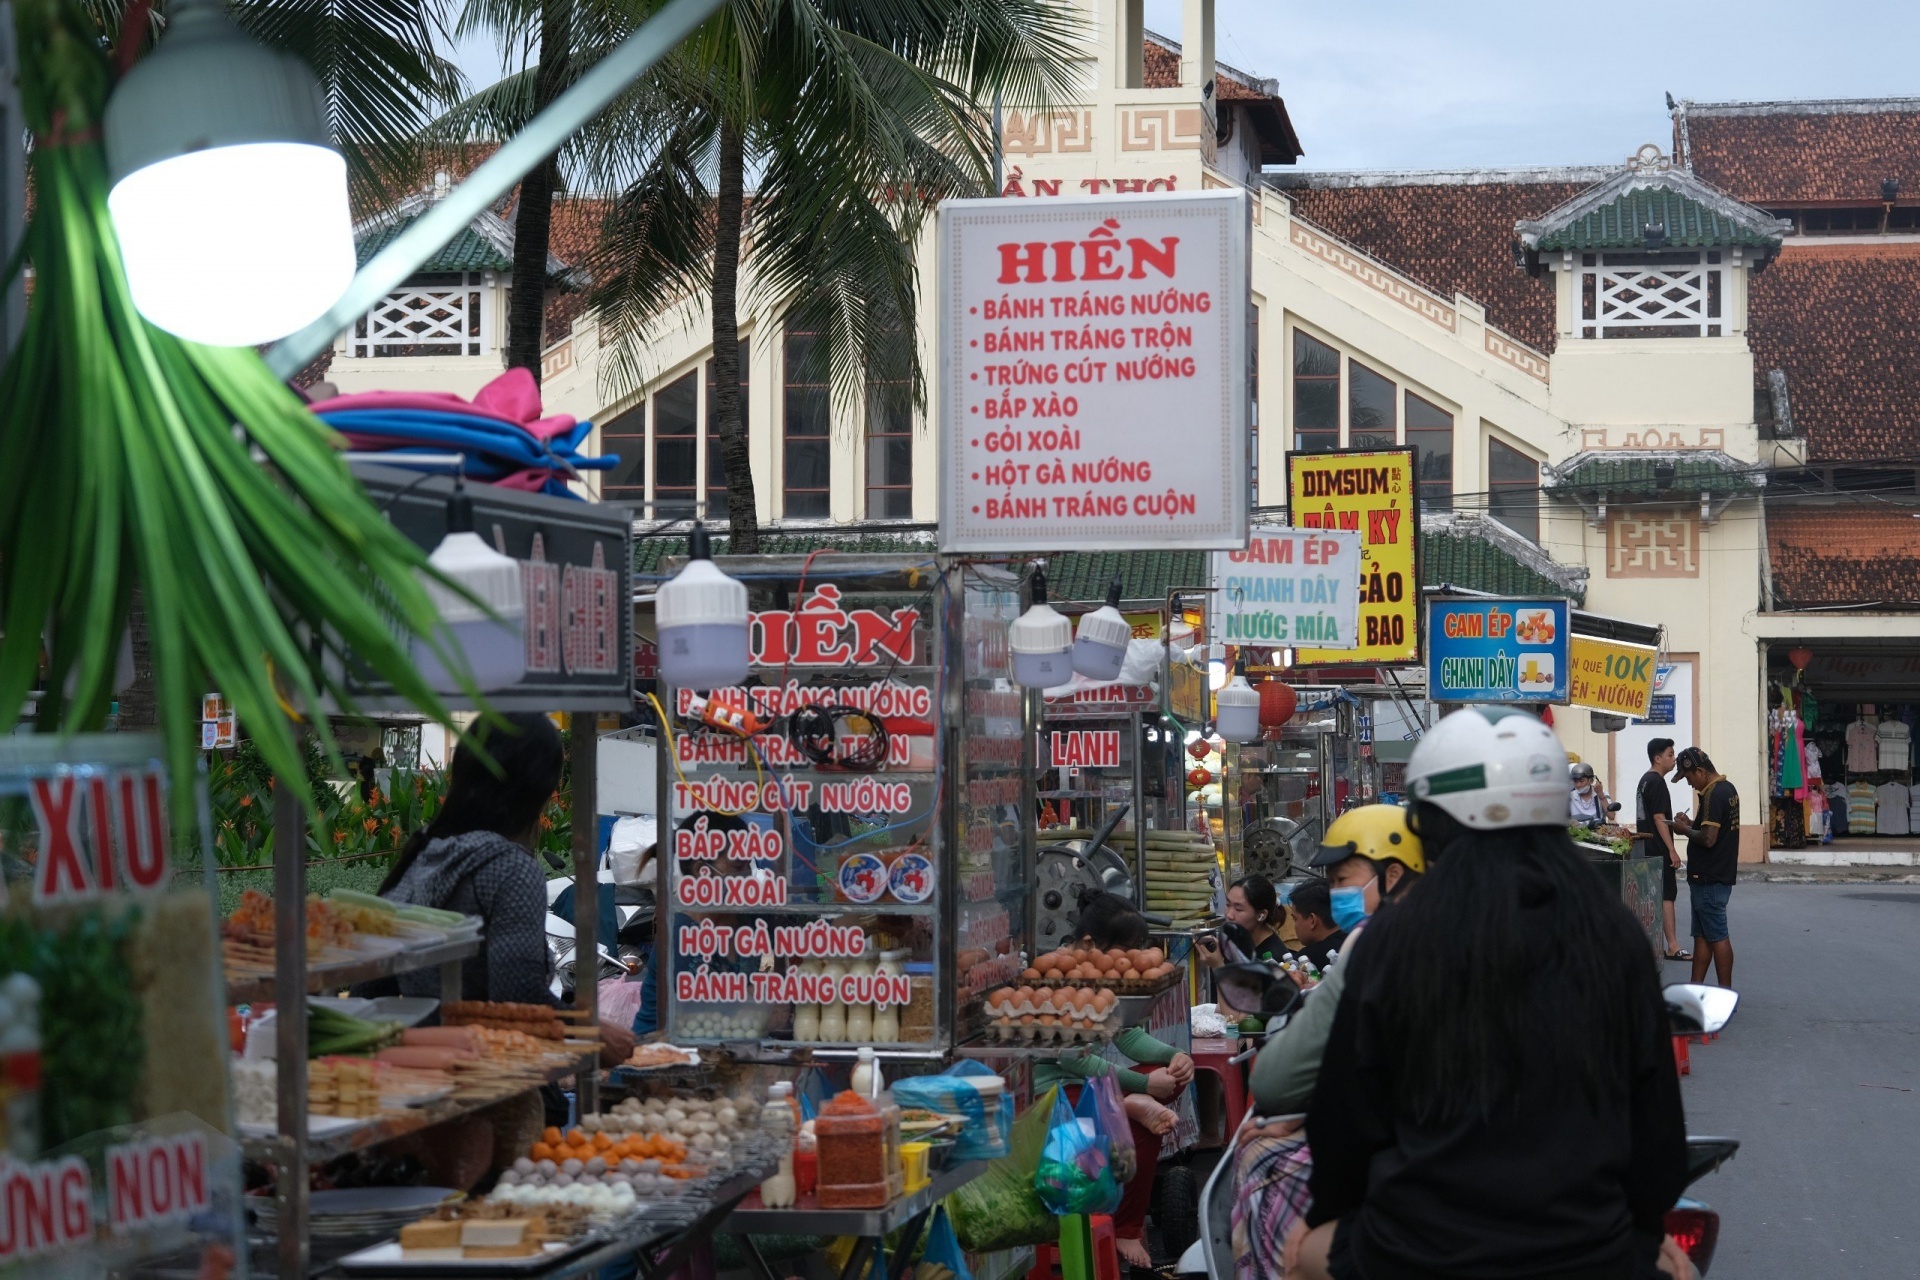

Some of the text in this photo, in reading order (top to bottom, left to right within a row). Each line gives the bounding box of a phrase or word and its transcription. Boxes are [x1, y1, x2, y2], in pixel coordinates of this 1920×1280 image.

[998, 218, 1179, 284] HIỀN
[983, 287, 1212, 321] BÁNH TRÁNG NƯỚNG
[983, 320, 1193, 354] BÁNH TRÁNG TRỘN
[984, 353, 1197, 386] TRỨNG CÚT NƯỚNG
[984, 387, 1079, 420] BẮP XÀO
[984, 424, 1081, 453] GỎI XOÀI
[985, 456, 1152, 489] HỘT GÀ NƯỚNG
[1302, 467, 1389, 497] DIMSUM
[985, 489, 1197, 520] BÁNH TRÁNG CUỘN
[1368, 499, 1401, 545] KÝ
[1303, 534, 1340, 565] ÉP
[1226, 573, 1340, 604] CHANH DÂY
[750, 584, 920, 666] IỀN
[1226, 609, 1288, 640] NƯỚC
[1295, 610, 1339, 641] MÍA
[1366, 614, 1404, 646] BAO
[1445, 607, 1512, 638] CAM ÉP
[1442, 648, 1516, 689] CHANH DÂY
[1582, 659, 1603, 673] QUE
[1605, 653, 1651, 682] 10K
[678, 686, 746, 716] BNH
[1597, 683, 1644, 709] NƯỚNG
[678, 725, 747, 765] BÁNH
[840, 735, 911, 765] TRN
[1052, 731, 1120, 775] LẠNH
[675, 775, 911, 812] TRỨNG CÚT NƯỚNG
[677, 816, 783, 860] BẮP XÀO
[678, 866, 787, 905] GỎI XOÀI
[680, 918, 864, 962] HỘT GÀ NƯỚNG
[677, 965, 912, 1010] BÁNH TRÁNG CUỘN
[112, 1138, 207, 1226] NON
